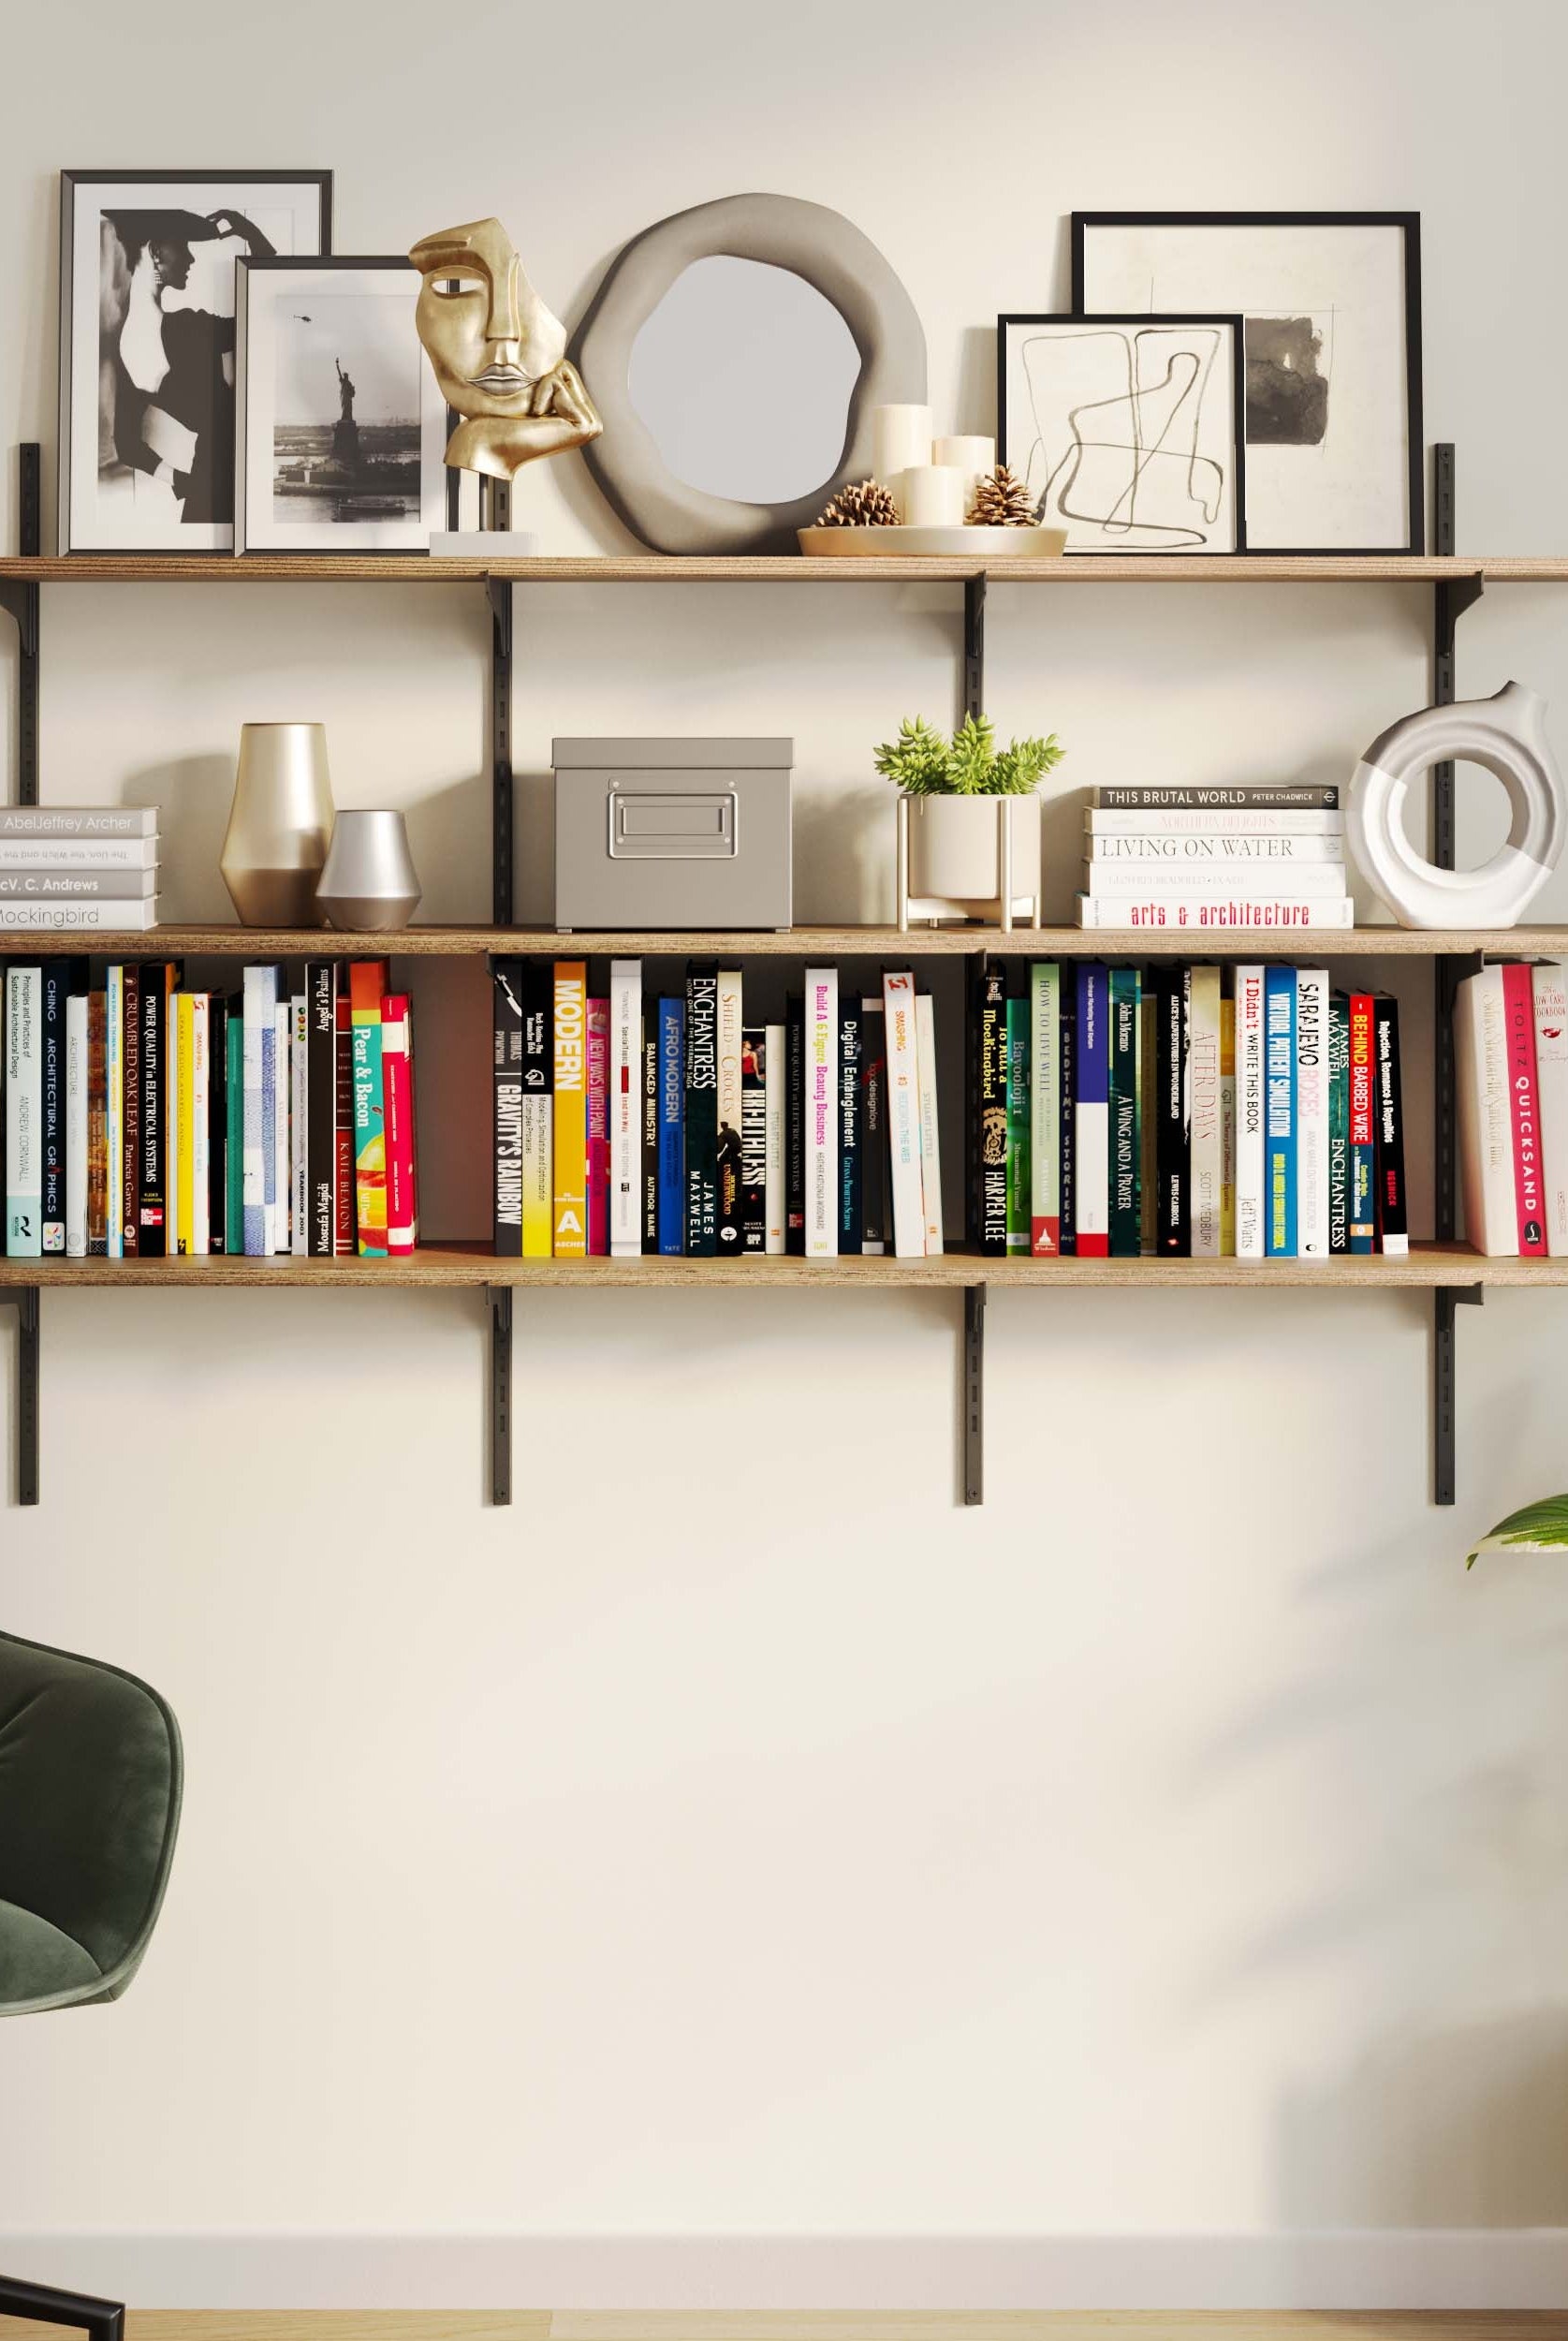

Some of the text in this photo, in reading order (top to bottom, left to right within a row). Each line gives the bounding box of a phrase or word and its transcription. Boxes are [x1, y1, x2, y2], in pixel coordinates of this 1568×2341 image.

[1107, 791, 1246, 802] THIS BRUTAL WORLD
[85, 817, 132, 830] Archer
[1101, 839, 1294, 857] LIVING ON WATER
[24, 878, 39, 891] C.
[42, 878, 99, 891] Andrews
[1131, 902, 1310, 925] arts & architecture
[22, 976, 32, 1006] Principles
[48, 979, 56, 1022] CHING
[145, 995, 156, 1026] POWER
[315, 969, 333, 1032] Angel's Psalms
[816, 985, 828, 1010] Build
[1039, 980, 1050, 1007] HOW
[1246, 988, 1260, 1029] Didn't
[9, 976, 20, 1079] Sustainable Architectural Design
[23, 1008, 32, 1019] and
[23, 1020, 32, 1050] Practices
[554, 979, 583, 1090] MODERN
[693, 979, 717, 1089] ENCHANTRESS
[721, 994, 738, 1042] SHIELD
[895, 1010, 907, 1052] SMASHING
[1039, 1012, 1050, 1027] TO
[1119, 1003, 1132, 1052] John Morano
[1268, 993, 1291, 1036] VIRTUAL
[1298, 983, 1319, 1066] SARAJEVO
[143, 1029, 156, 1069] QUALITY
[510, 1031, 522, 1061] THOMAS
[590, 1038, 605, 1060] NEW
[666, 1016, 679, 1057] AFRO
[813, 1032, 828, 1064] Figure
[982, 1009, 997, 1098] Mockingbird
[1039, 1033, 1050, 1057] LIVE
[1171, 994, 1180, 1119] ALICE'S ADVENTURES IN WONDERLAND
[1246, 1033, 1259, 1068] WRITE
[1268, 1038, 1291, 1078] PATIENT
[1328, 1009, 1340, 1083] MAXWELL
[1338, 1024, 1349, 1068] JAMES
[1378, 1021, 1391, 1061] Rejection,
[69, 1037, 78, 1097] ARCHITECTURE
[125, 993, 138, 1136] CRUMBLED OAK LEAF
[354, 1027, 374, 1127] Pear & Bacon
[590, 1060, 605, 1085] WAYS
[791, 1055, 799, 1092] QUALITY
[813, 1066, 828, 1100] Beauty
[841, 1021, 857, 1147] Digital Entanglement
[1009, 1041, 1025, 1105] Bayooloji
[1039, 1062, 1050, 1093] WELL
[1194, 1031, 1216, 1140] AFTER DAYS
[1246, 1072, 1259, 1098] THIS
[1353, 1014, 1368, 1141] BEHIND BARBED WIRE
[1382, 1062, 1392, 1098] Romance
[47, 1038, 56, 1138] ARCHITECTURAL
[145, 1081, 156, 1138] ELECTRICAL
[590, 1086, 605, 1112] WITH
[646, 1042, 656, 1147] BALANCED MINISTRY
[666, 1059, 679, 1123] MODERN
[1118, 1096, 1134, 1105] A
[1268, 1079, 1291, 1137] SIMULATION
[1299, 1069, 1320, 1117] ROSES
[1514, 1003, 1537, 1211] TOLTZ QUICKSAND
[590, 1113, 605, 1140] PAINT
[742, 1089, 766, 1185] BREATHLESS
[816, 1103, 828, 1145] Business
[1062, 1033, 1071, 1223] BEDTIME STORIES
[1118, 1106, 1134, 1137] WING
[1246, 1101, 1259, 1133] BOOK
[1382, 1107, 1395, 1143] Royalties
[19, 1096, 29, 1182] ANDREW CORNWALL
[497, 1084, 522, 1225] GRAVITY'S RAINBOW
[1118, 1138, 1132, 1161] AND
[125, 1144, 134, 1217] Patricia Gavros
[145, 1140, 156, 1183] SYSTEMS
[647, 1176, 655, 1238] AUTHOR NAME
[690, 1170, 700, 1247] MAXWELL
[703, 1182, 714, 1234] JAMES
[723, 1164, 731, 1215] UNDERWOOD
[985, 1171, 1006, 1241] HARPER LEE
[1118, 1173, 1134, 1210] PRAYER
[1171, 1174, 1180, 1226] LEWIS CARROLL
[1199, 1171, 1211, 1247] SCOTT MEDBURY
[1331, 1138, 1345, 1248] ENCHANTRESS
[316, 1215, 330, 1252] Mostafa
[557, 1210, 582, 1233] A
[1238, 1197, 1257, 1249] Jeff Watts
